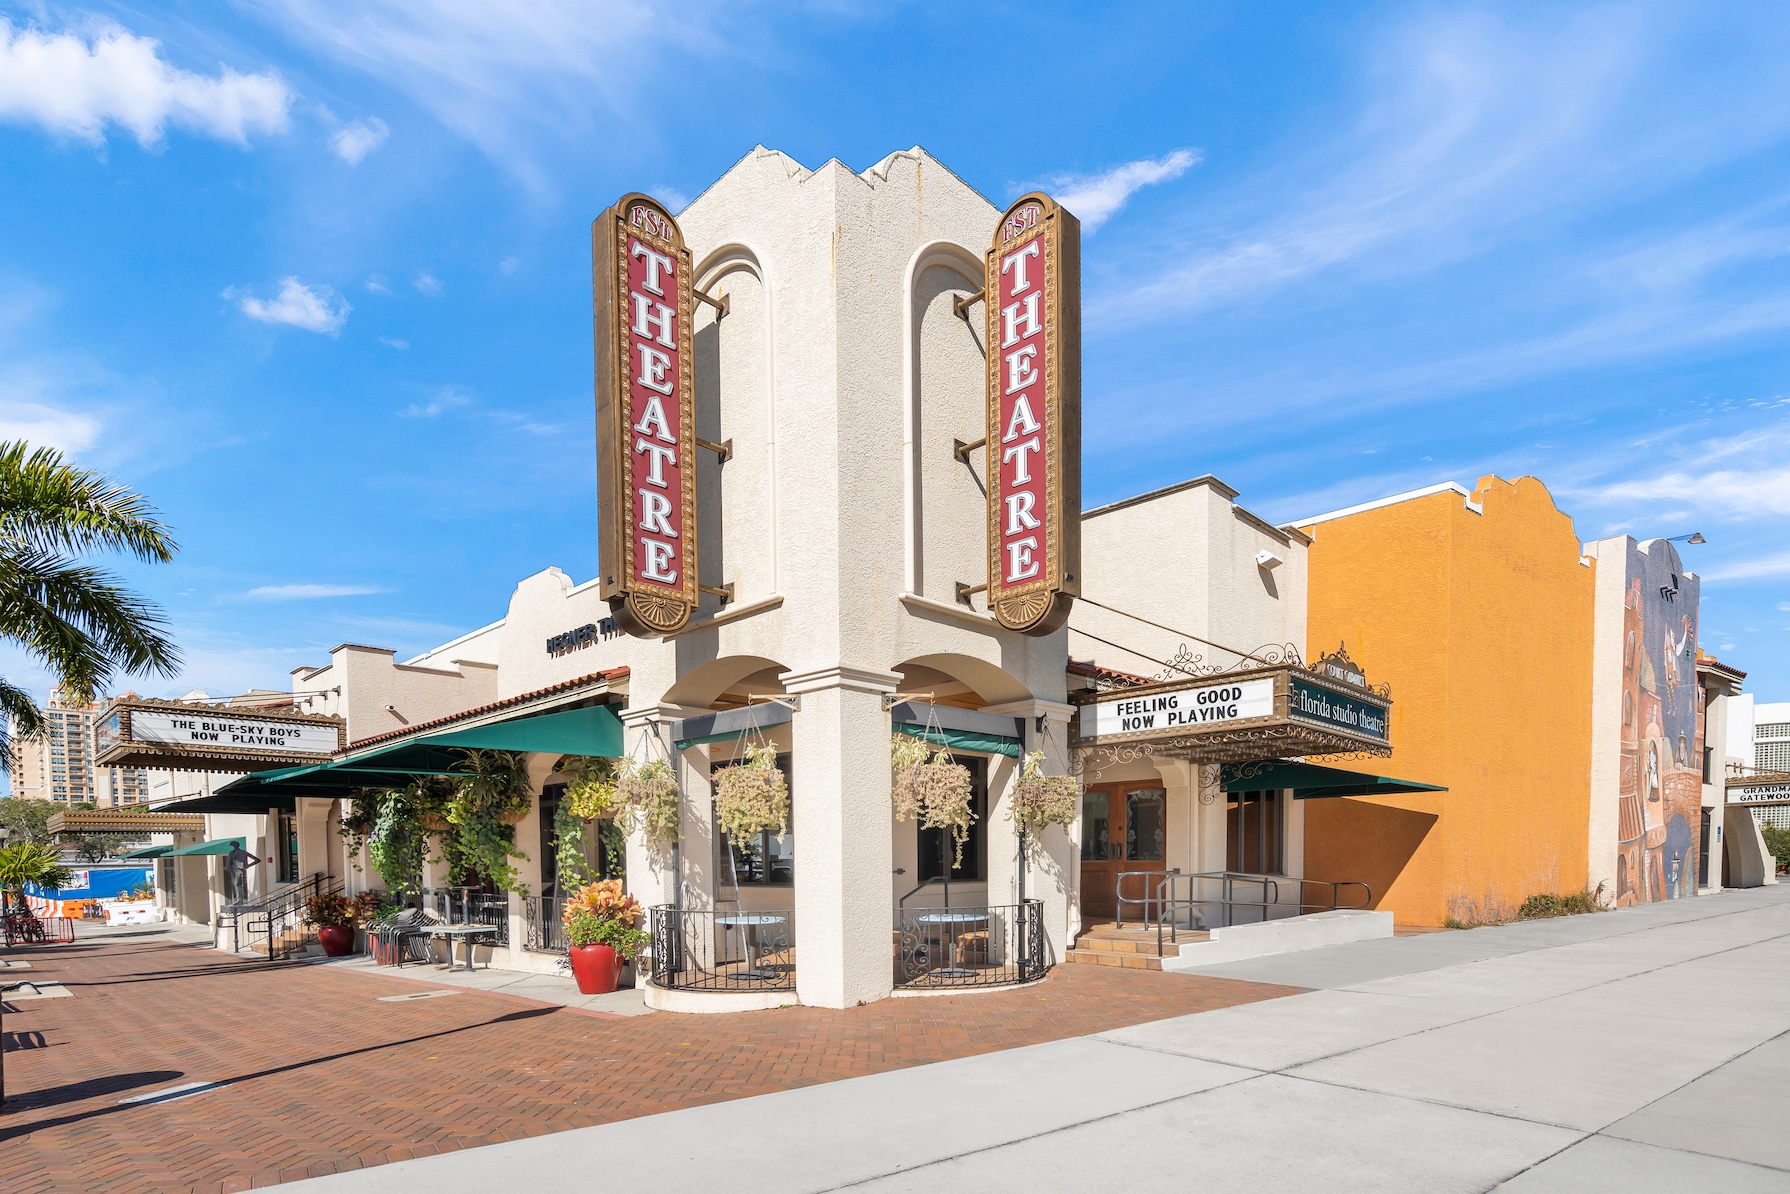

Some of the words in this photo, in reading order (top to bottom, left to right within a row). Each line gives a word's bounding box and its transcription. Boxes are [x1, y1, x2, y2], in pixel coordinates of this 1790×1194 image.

[1002, 206, 1040, 245] FST
[631, 240, 678, 584] THEATRE
[1001, 240, 1042, 584] THEATRE
[1117, 696, 1178, 716] FEELING
[1197, 687, 1242, 705] GOOD
[1122, 715, 1154, 731] NOW
[1168, 704, 1238, 725] PLAYING
[1300, 690, 1331, 718] florida
[1332, 703, 1357, 726] studio
[1359, 709, 1384, 733] theatre
[171, 720, 196, 730] THE
[202, 722, 264, 735] BLUE-SKY
[269, 728, 301, 738] BOYS
[191, 731, 219, 741] NOW
[232, 735, 285, 746] PLAYING
